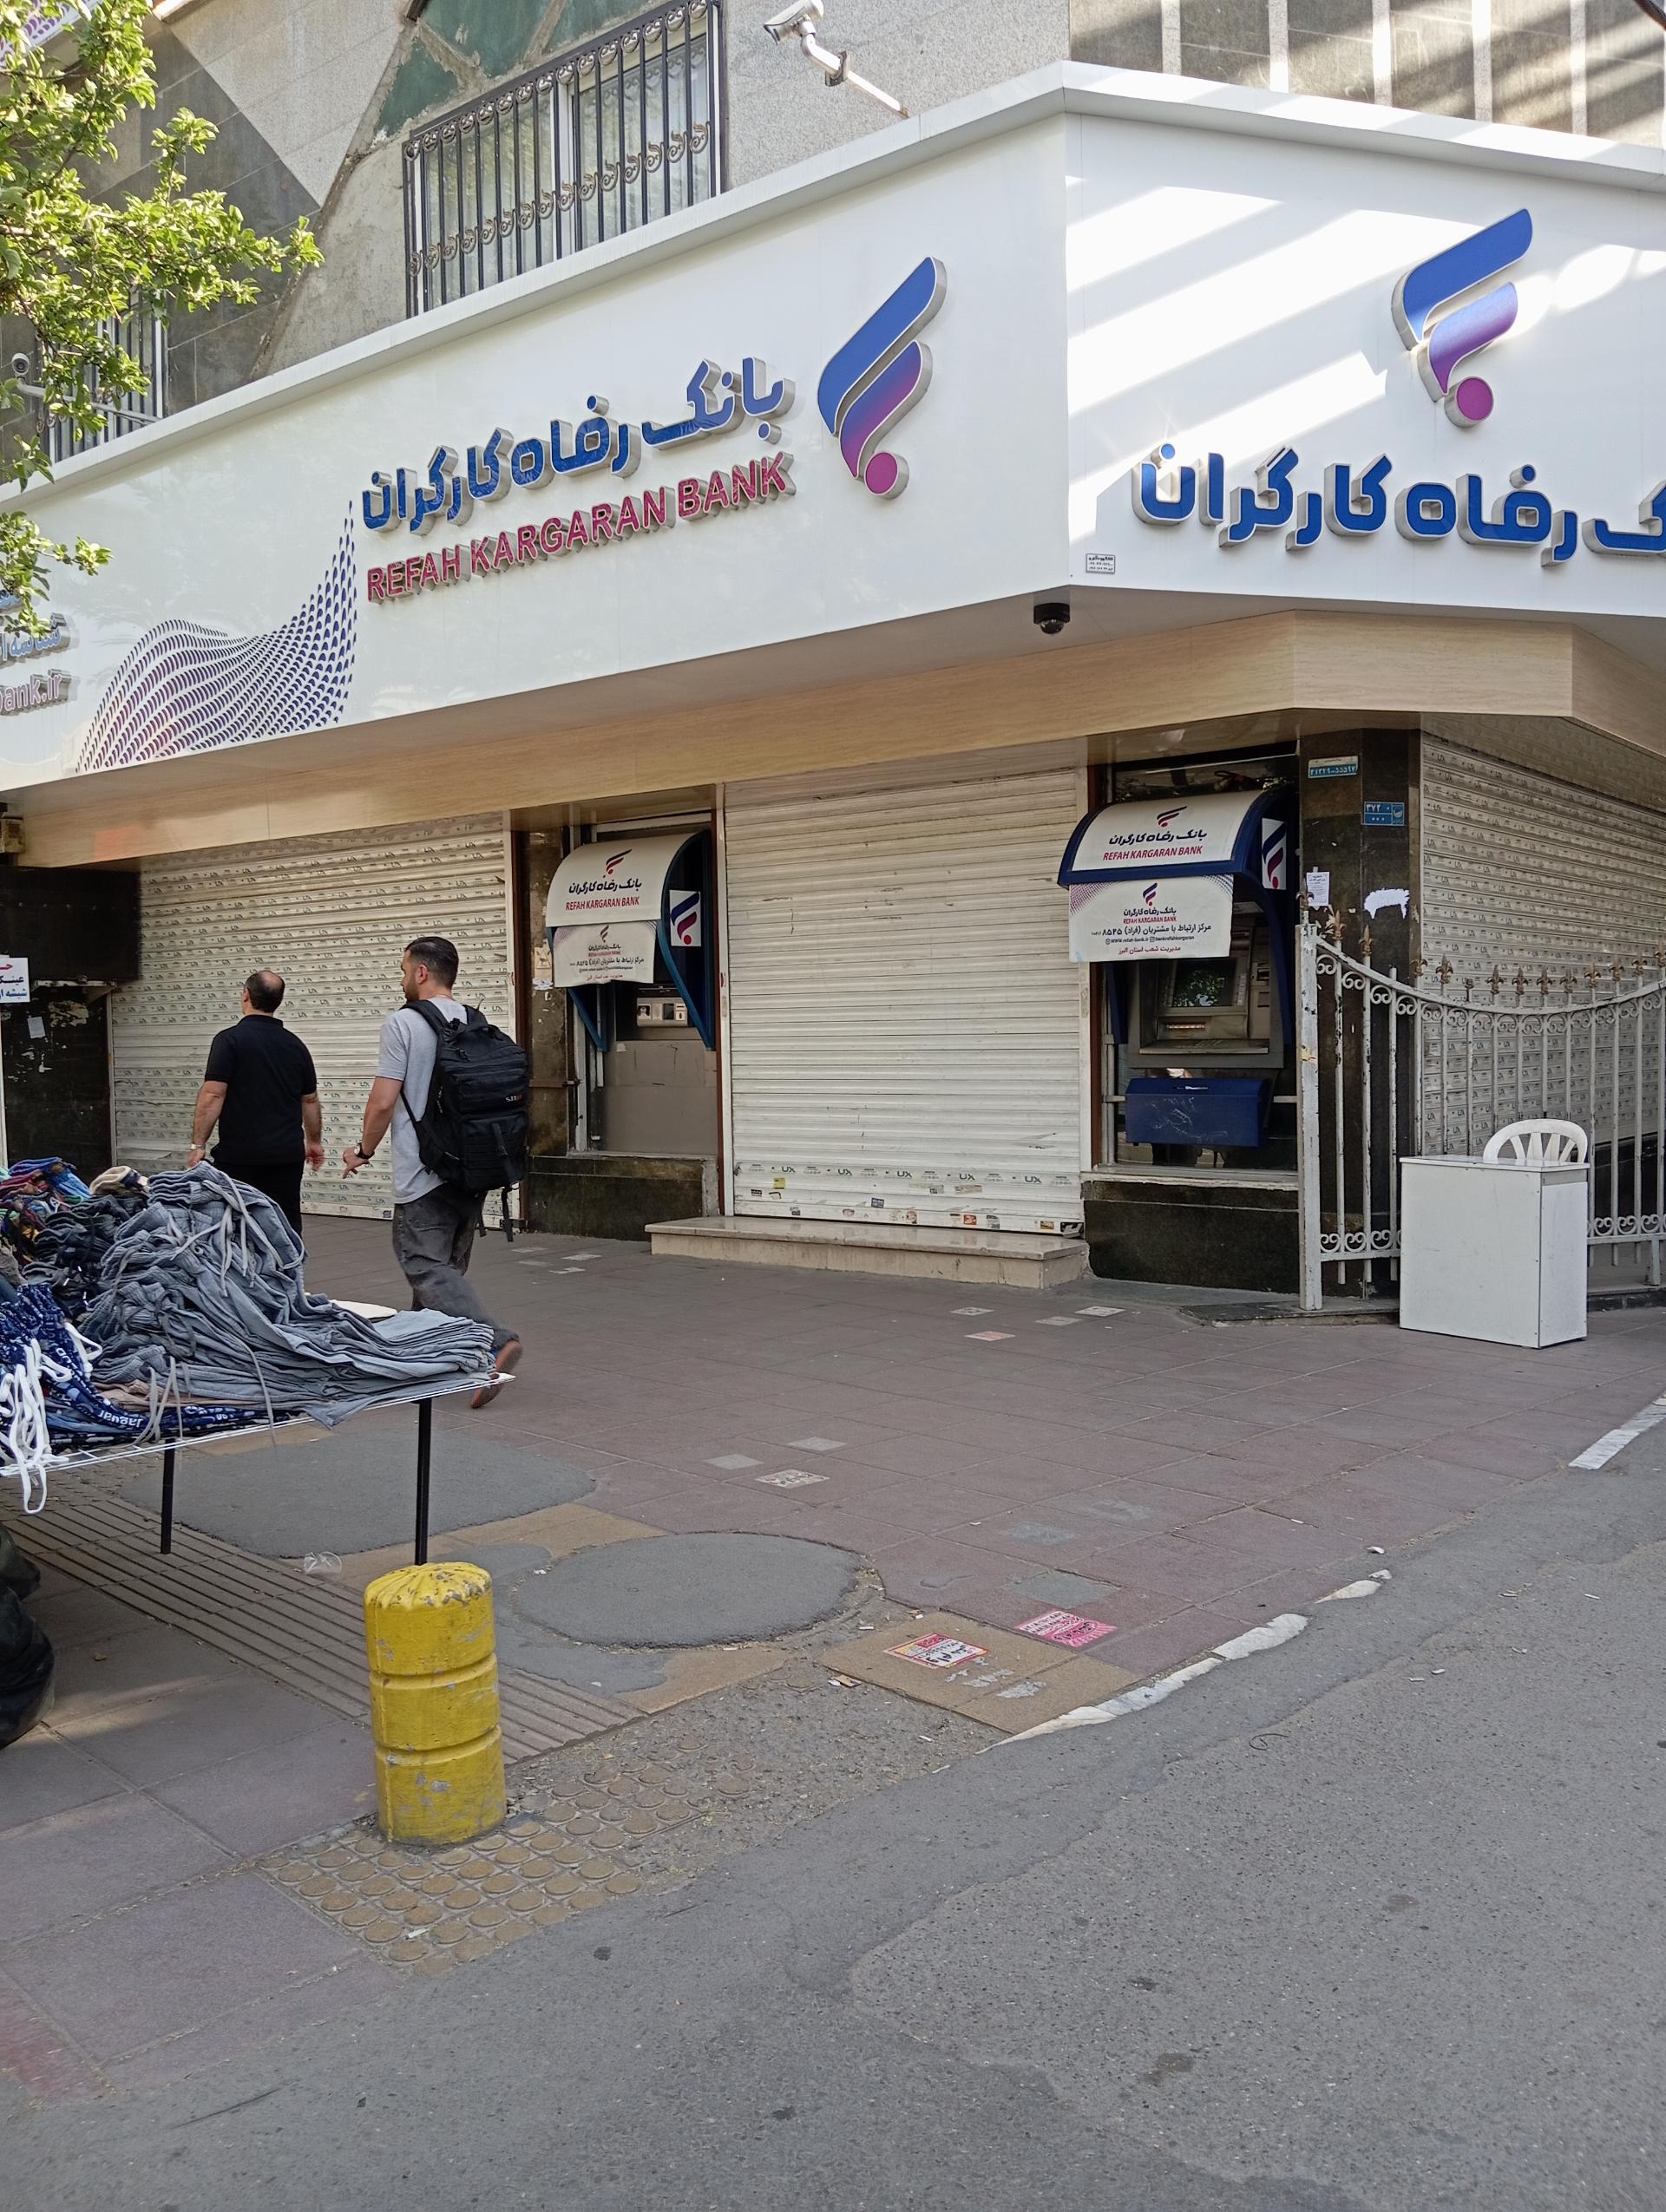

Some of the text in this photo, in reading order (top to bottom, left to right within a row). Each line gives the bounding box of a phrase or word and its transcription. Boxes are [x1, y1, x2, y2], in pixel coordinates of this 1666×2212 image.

[362, 357, 791, 534] بانک رفاه کارگران
[1133, 442, 1393, 550] کارگران
[1396, 462, 1577, 566] رفاه
[367, 451, 788, 602] REFAH KARGARAN BANK
[1109, 829, 1207, 846] بانک رفاه کارگران
[1103, 846, 1204, 861] REFAH KARGARAN BANK
[619, 878, 642, 891] بانک
[566, 896, 640, 911] REFAH KARGARAN BANK
[1197, 923, 1211, 933] مرکز
